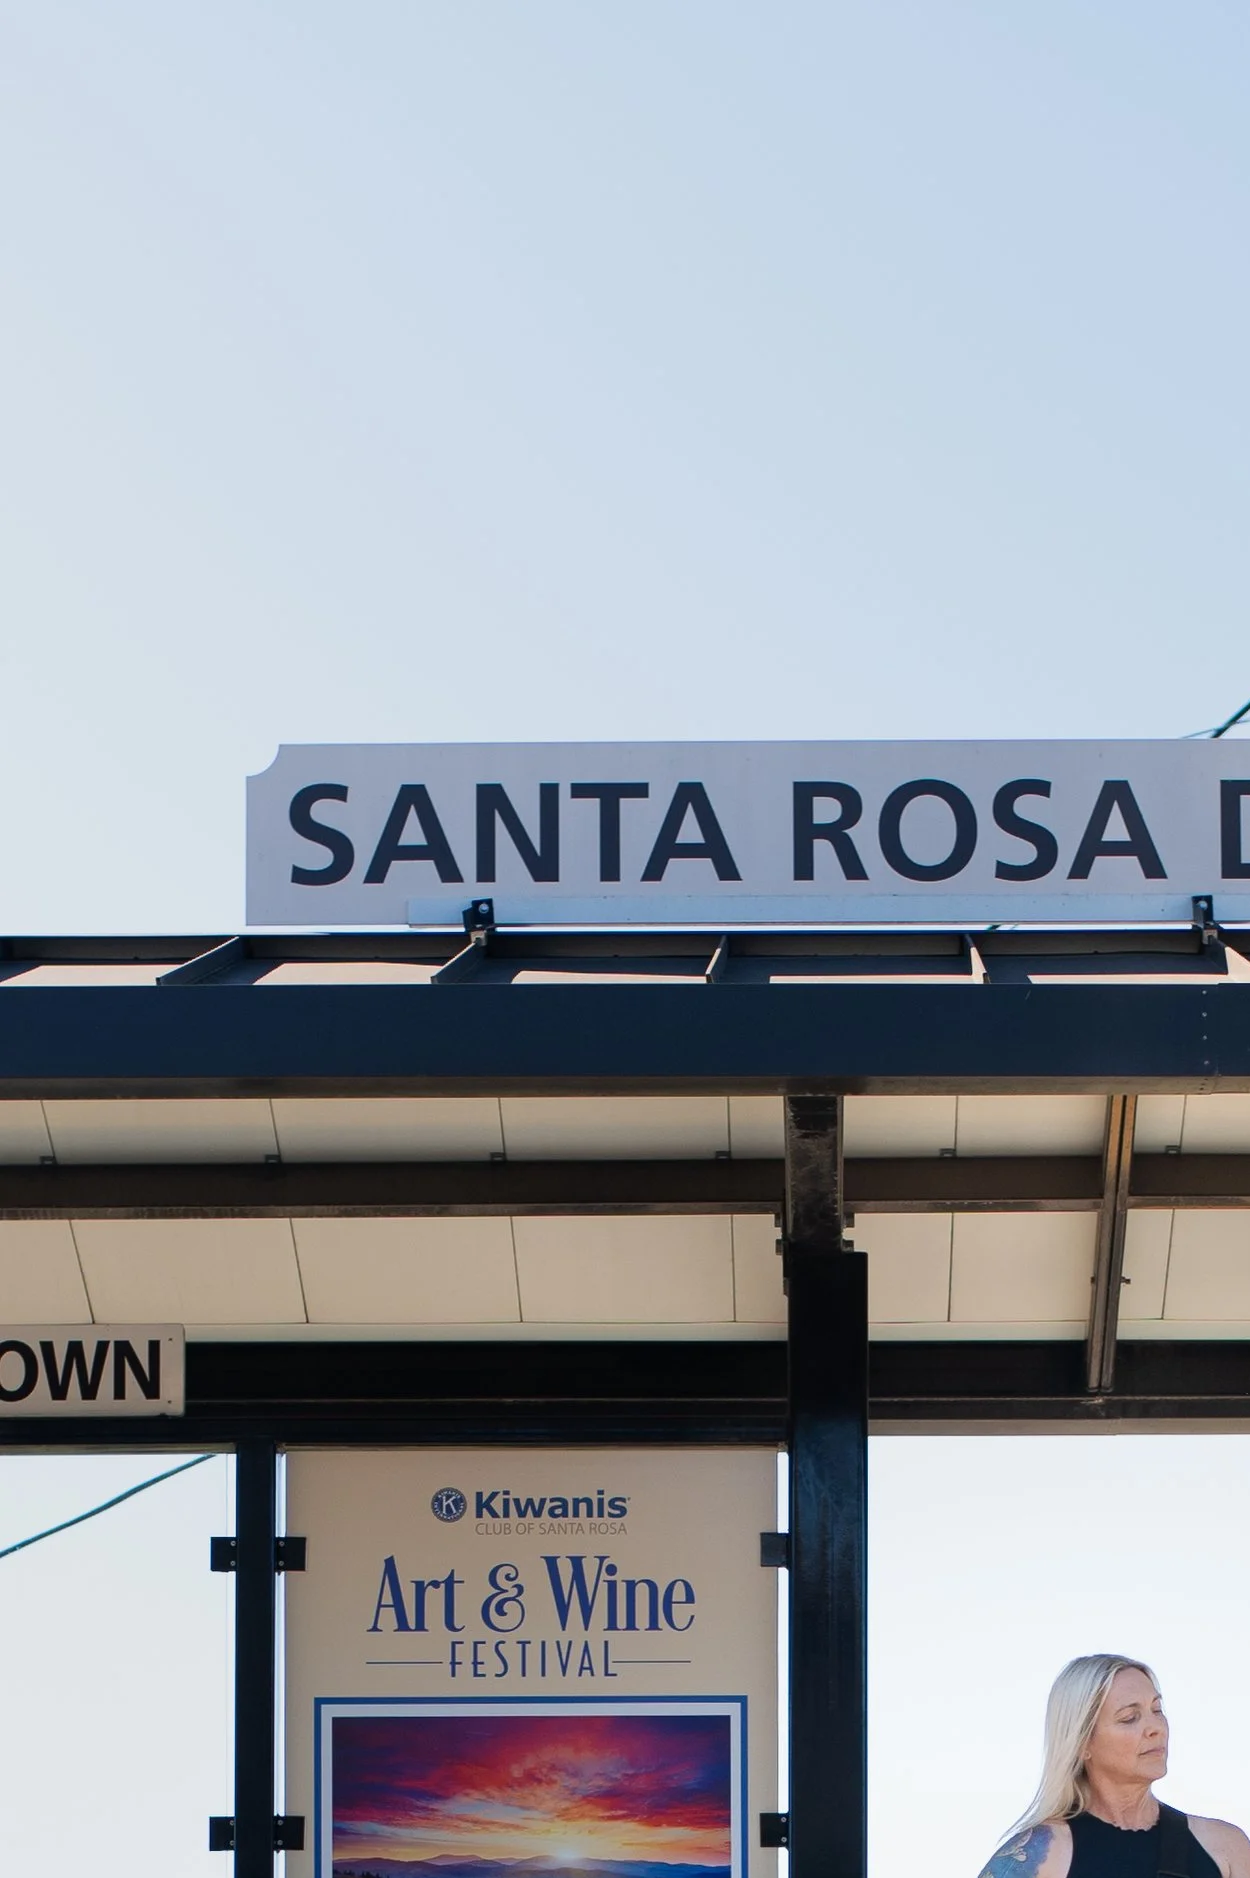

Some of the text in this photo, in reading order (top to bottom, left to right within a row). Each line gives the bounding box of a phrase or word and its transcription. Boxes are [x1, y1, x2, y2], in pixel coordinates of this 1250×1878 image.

[288, 781, 743, 887] SANTA
[792, 777, 1168, 883] ROSA
[0, 1340, 161, 1402] OWN
[475, 1489, 628, 1520] Kiwanis
[475, 1522, 628, 1536] CLUB OF SANTA ROSA
[366, 1555, 696, 1633] Art & Wine
[449, 1640, 618, 1678] FESTIVAL
